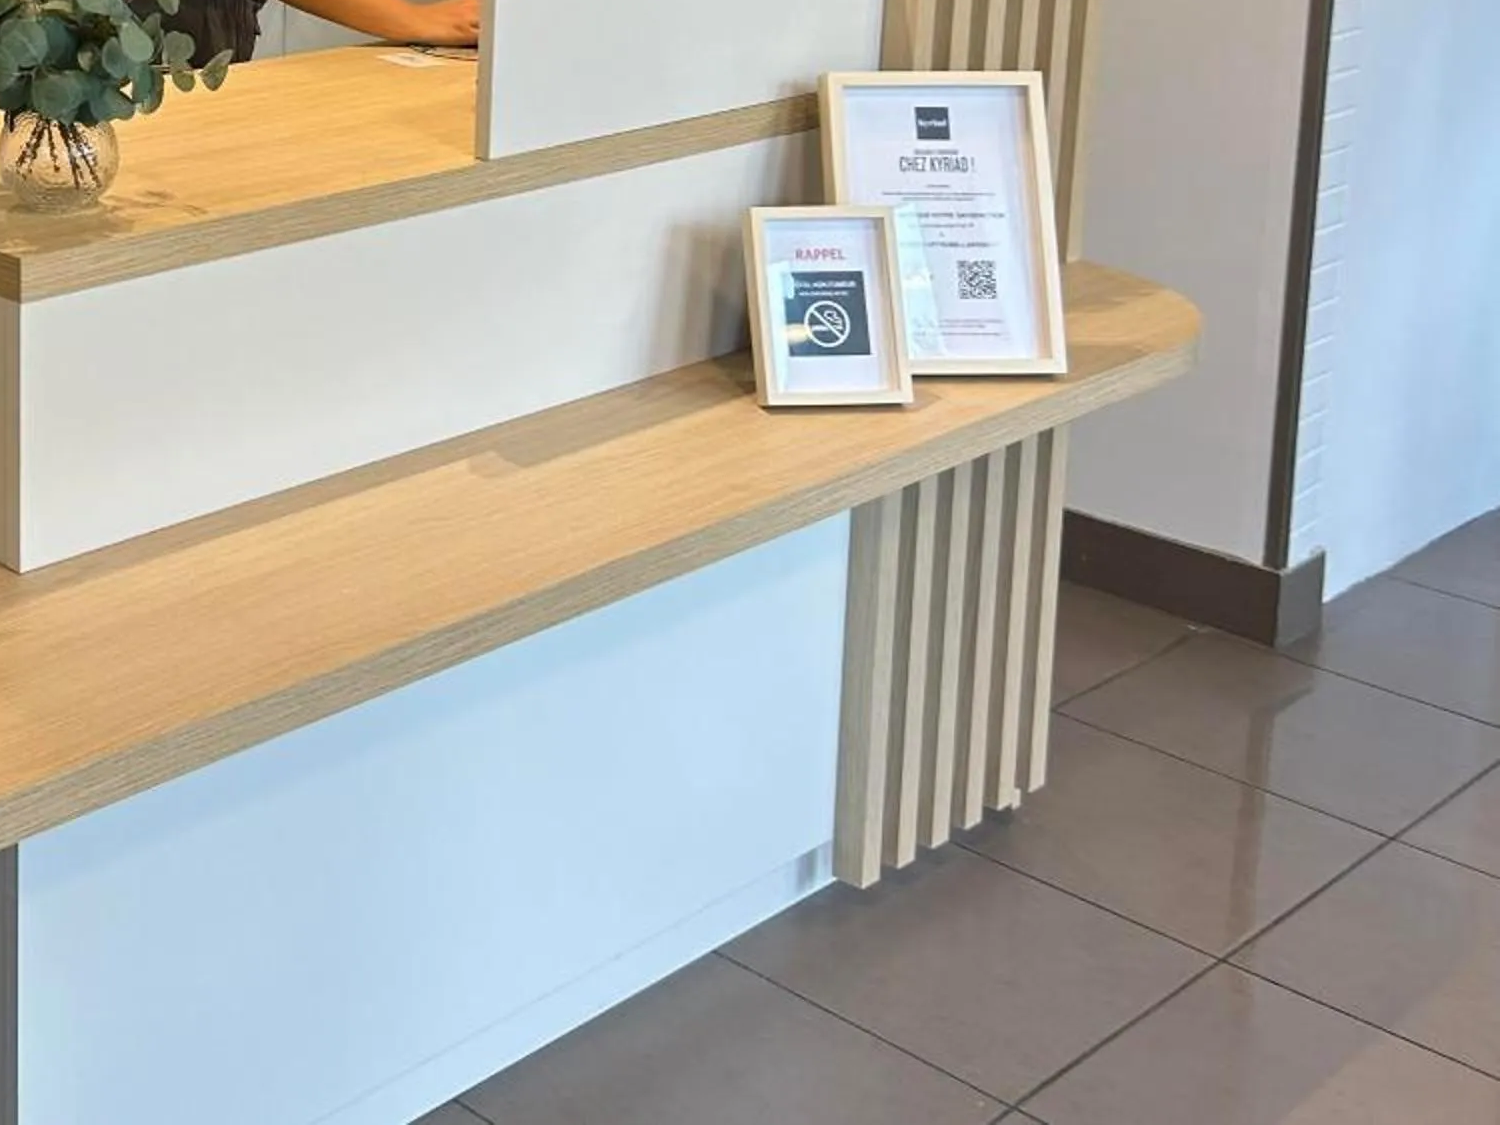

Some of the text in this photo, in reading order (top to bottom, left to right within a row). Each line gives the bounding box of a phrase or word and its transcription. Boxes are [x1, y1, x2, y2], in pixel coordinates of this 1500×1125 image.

[899, 156, 927, 172] CHEZ
[929, 156, 969, 173] KYRIAD
[795, 248, 846, 261] RAPPEL
